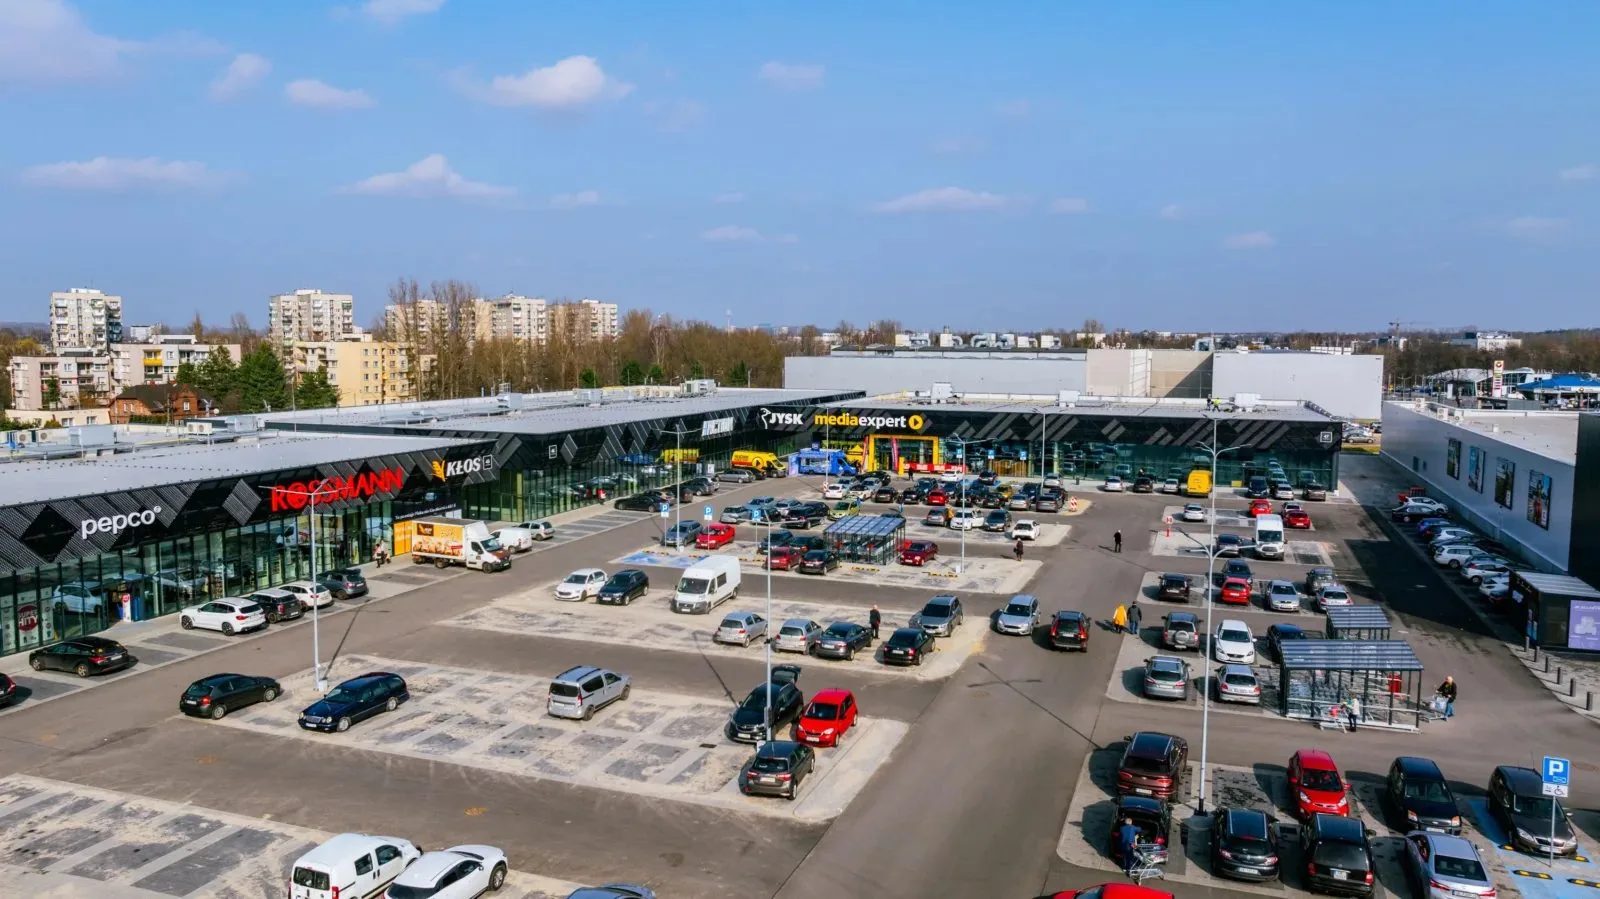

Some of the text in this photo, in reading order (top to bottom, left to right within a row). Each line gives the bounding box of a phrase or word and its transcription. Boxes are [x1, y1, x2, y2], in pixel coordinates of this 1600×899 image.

[770, 412, 803, 425] JYSK
[814, 412, 907, 430] mediaexpert
[446, 457, 481, 477] KŁOS
[271, 466, 404, 512] ROSSMANN
[81, 509, 156, 540] pepco
[1548, 759, 1564, 776] P
